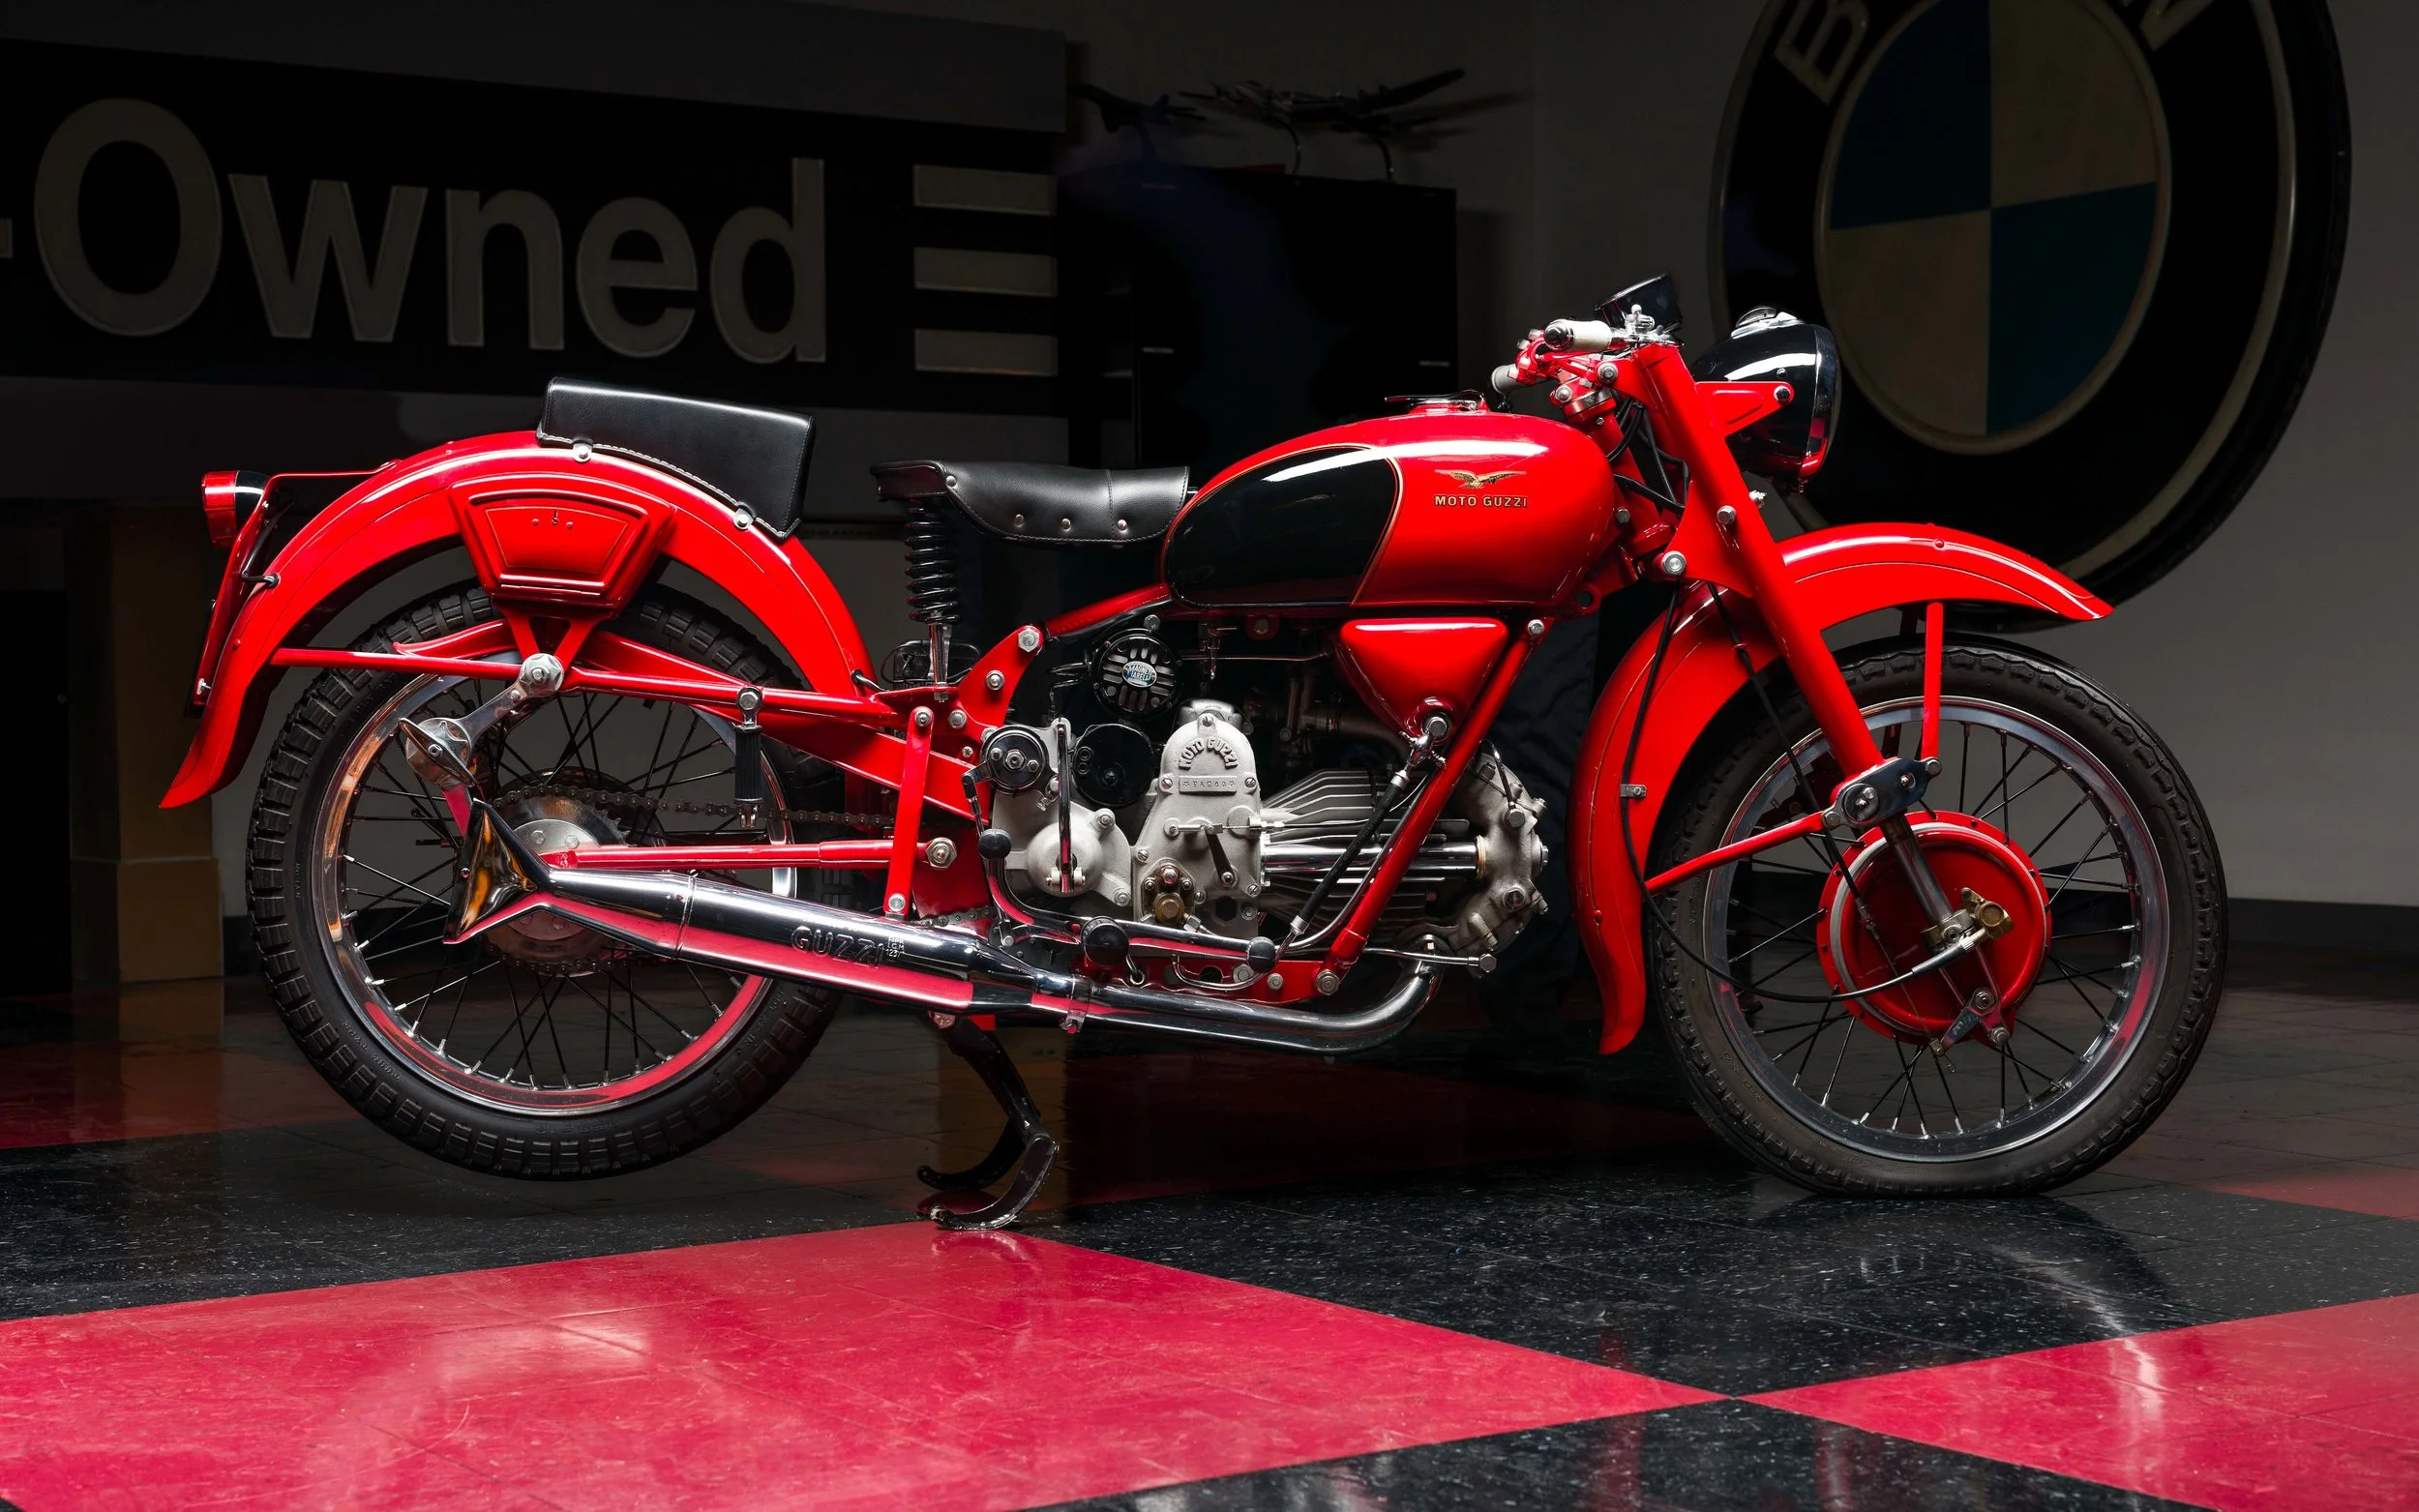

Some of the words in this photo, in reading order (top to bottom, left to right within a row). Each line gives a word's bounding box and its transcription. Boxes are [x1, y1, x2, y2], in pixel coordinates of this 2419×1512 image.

[0, 97, 827, 364] Owned
[1434, 494, 1478, 507] MOTO
[1482, 496, 1528, 508] GUZZI
[1179, 738, 1204, 770] MOTO
[1207, 736, 1239, 770] GUZZI
[791, 926, 884, 968] GUZZI
